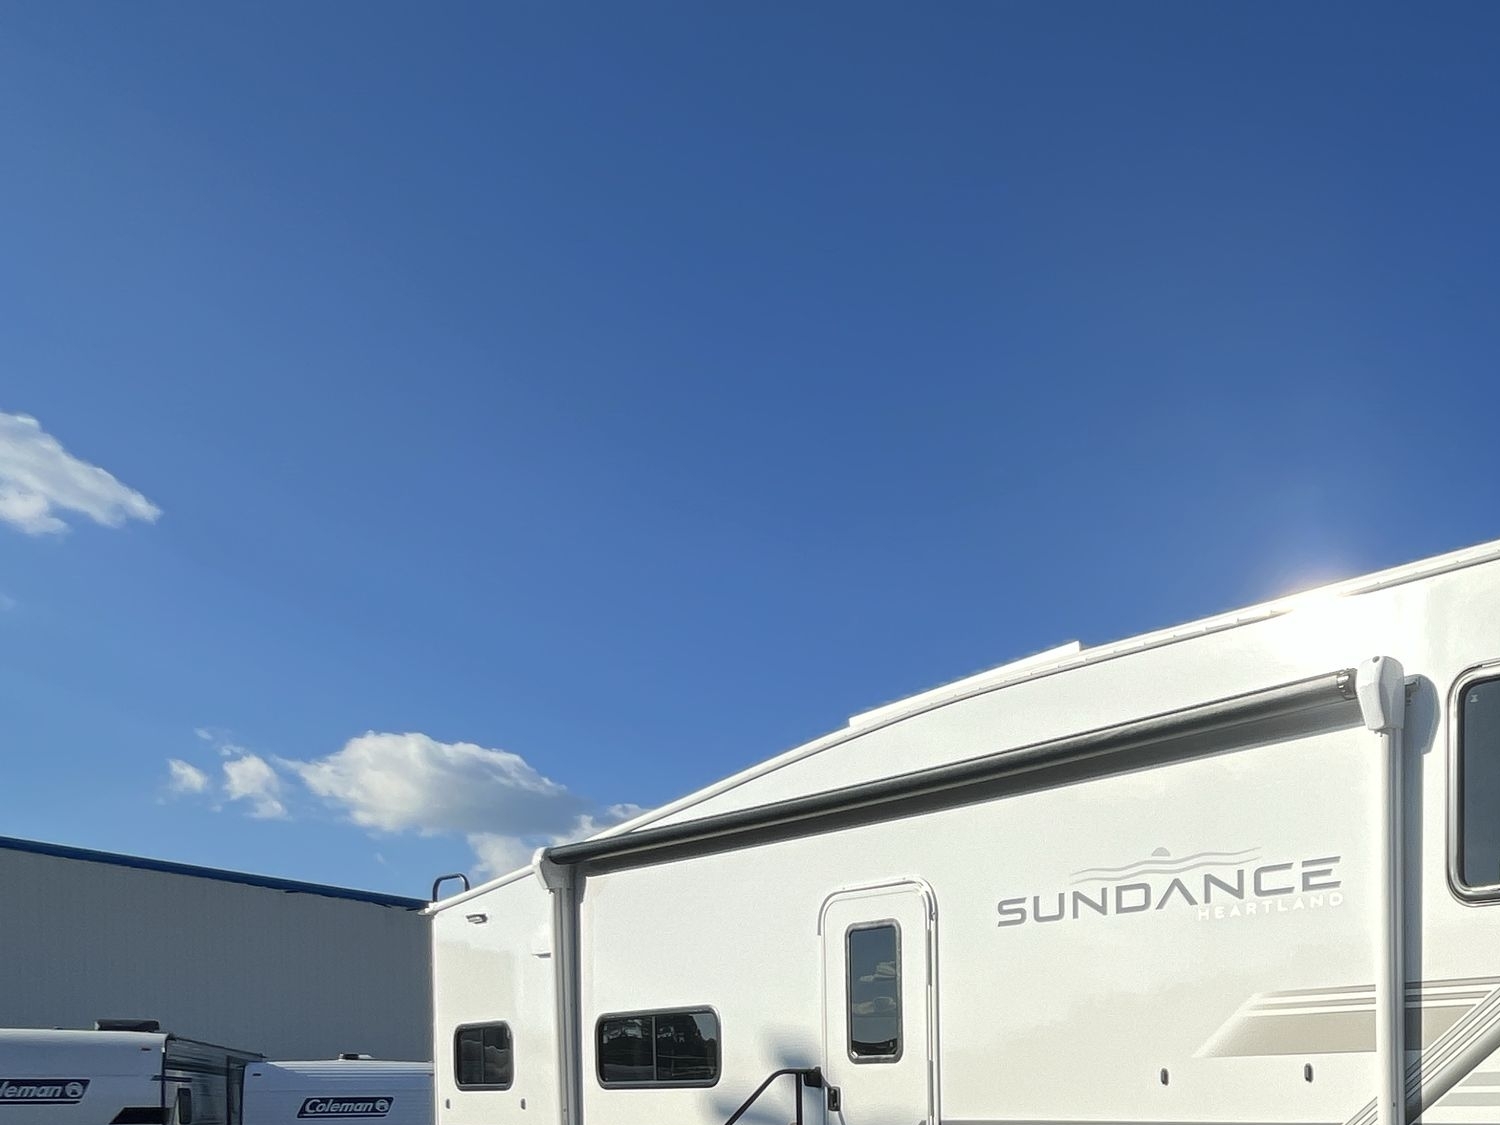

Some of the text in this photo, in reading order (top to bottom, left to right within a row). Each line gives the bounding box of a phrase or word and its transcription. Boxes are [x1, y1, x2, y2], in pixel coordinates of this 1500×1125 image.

[997, 856, 1342, 927] SUNDANCE
[1198, 893, 1343, 921] HEARTLAND
[305, 1099, 373, 1113] Coleman
